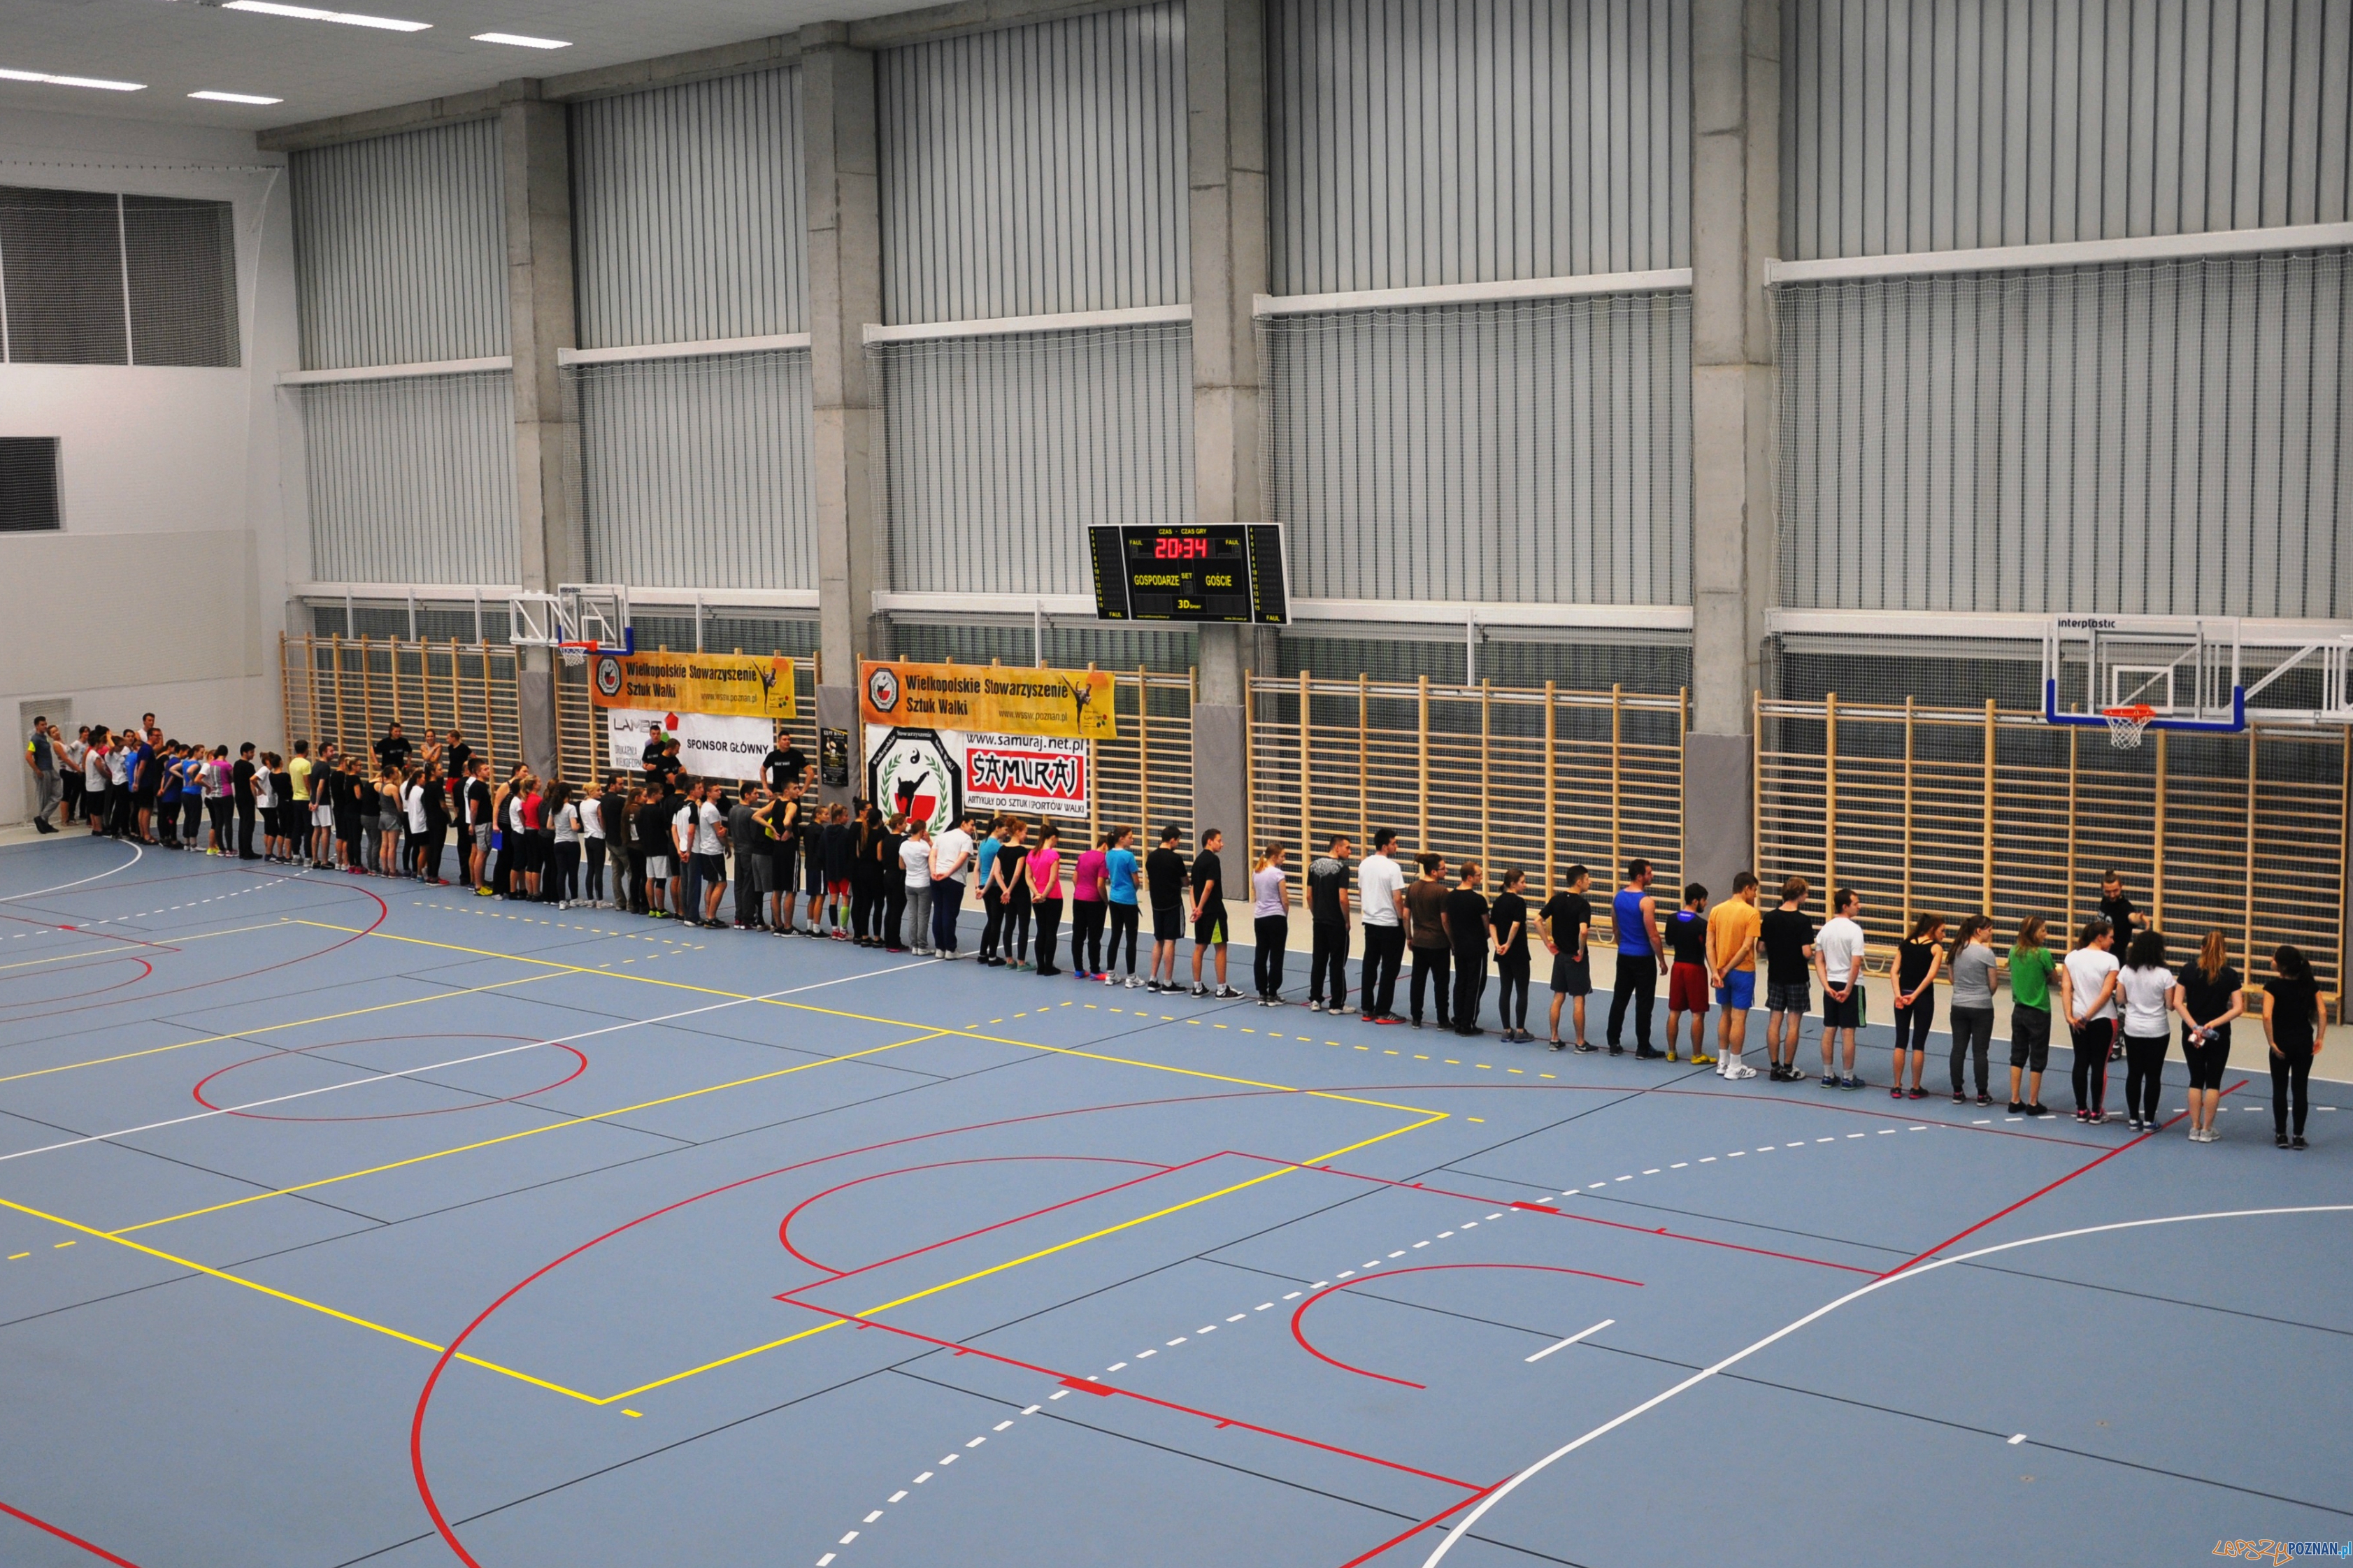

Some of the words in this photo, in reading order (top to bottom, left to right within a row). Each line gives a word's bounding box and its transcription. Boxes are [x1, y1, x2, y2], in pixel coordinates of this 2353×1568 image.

[1155, 538, 1207, 559] 20:34
[1134, 575, 1180, 587] GOSPODARZE
[1206, 573, 1232, 587] GOŚCIE
[1178, 599, 1190, 609] 3D
[2058, 618, 2115, 629] interplastic
[626, 662, 687, 679] Wielkopolskie
[689, 665, 757, 682] Stowarzyszenie
[627, 682, 651, 697] Sztuk
[653, 684, 676, 698] Walki
[905, 675, 980, 693] Wielkopolskie
[984, 678, 1068, 698] Stowarzyszenie
[906, 696, 936, 713] Sztuk
[938, 698, 968, 715] Walki
[999, 710, 1068, 723] www.wssw.poznan.pl
[687, 738, 728, 752] SPONSOR
[729, 741, 769, 755] GŁÓWNY
[966, 733, 1084, 754] www.samuraj.net.pl
[973, 752, 1078, 798] SAMURAJ
[996, 798, 1007, 807] DO
[1008, 798, 1028, 808] SZTUK
[1064, 803, 1085, 813] WALKI
